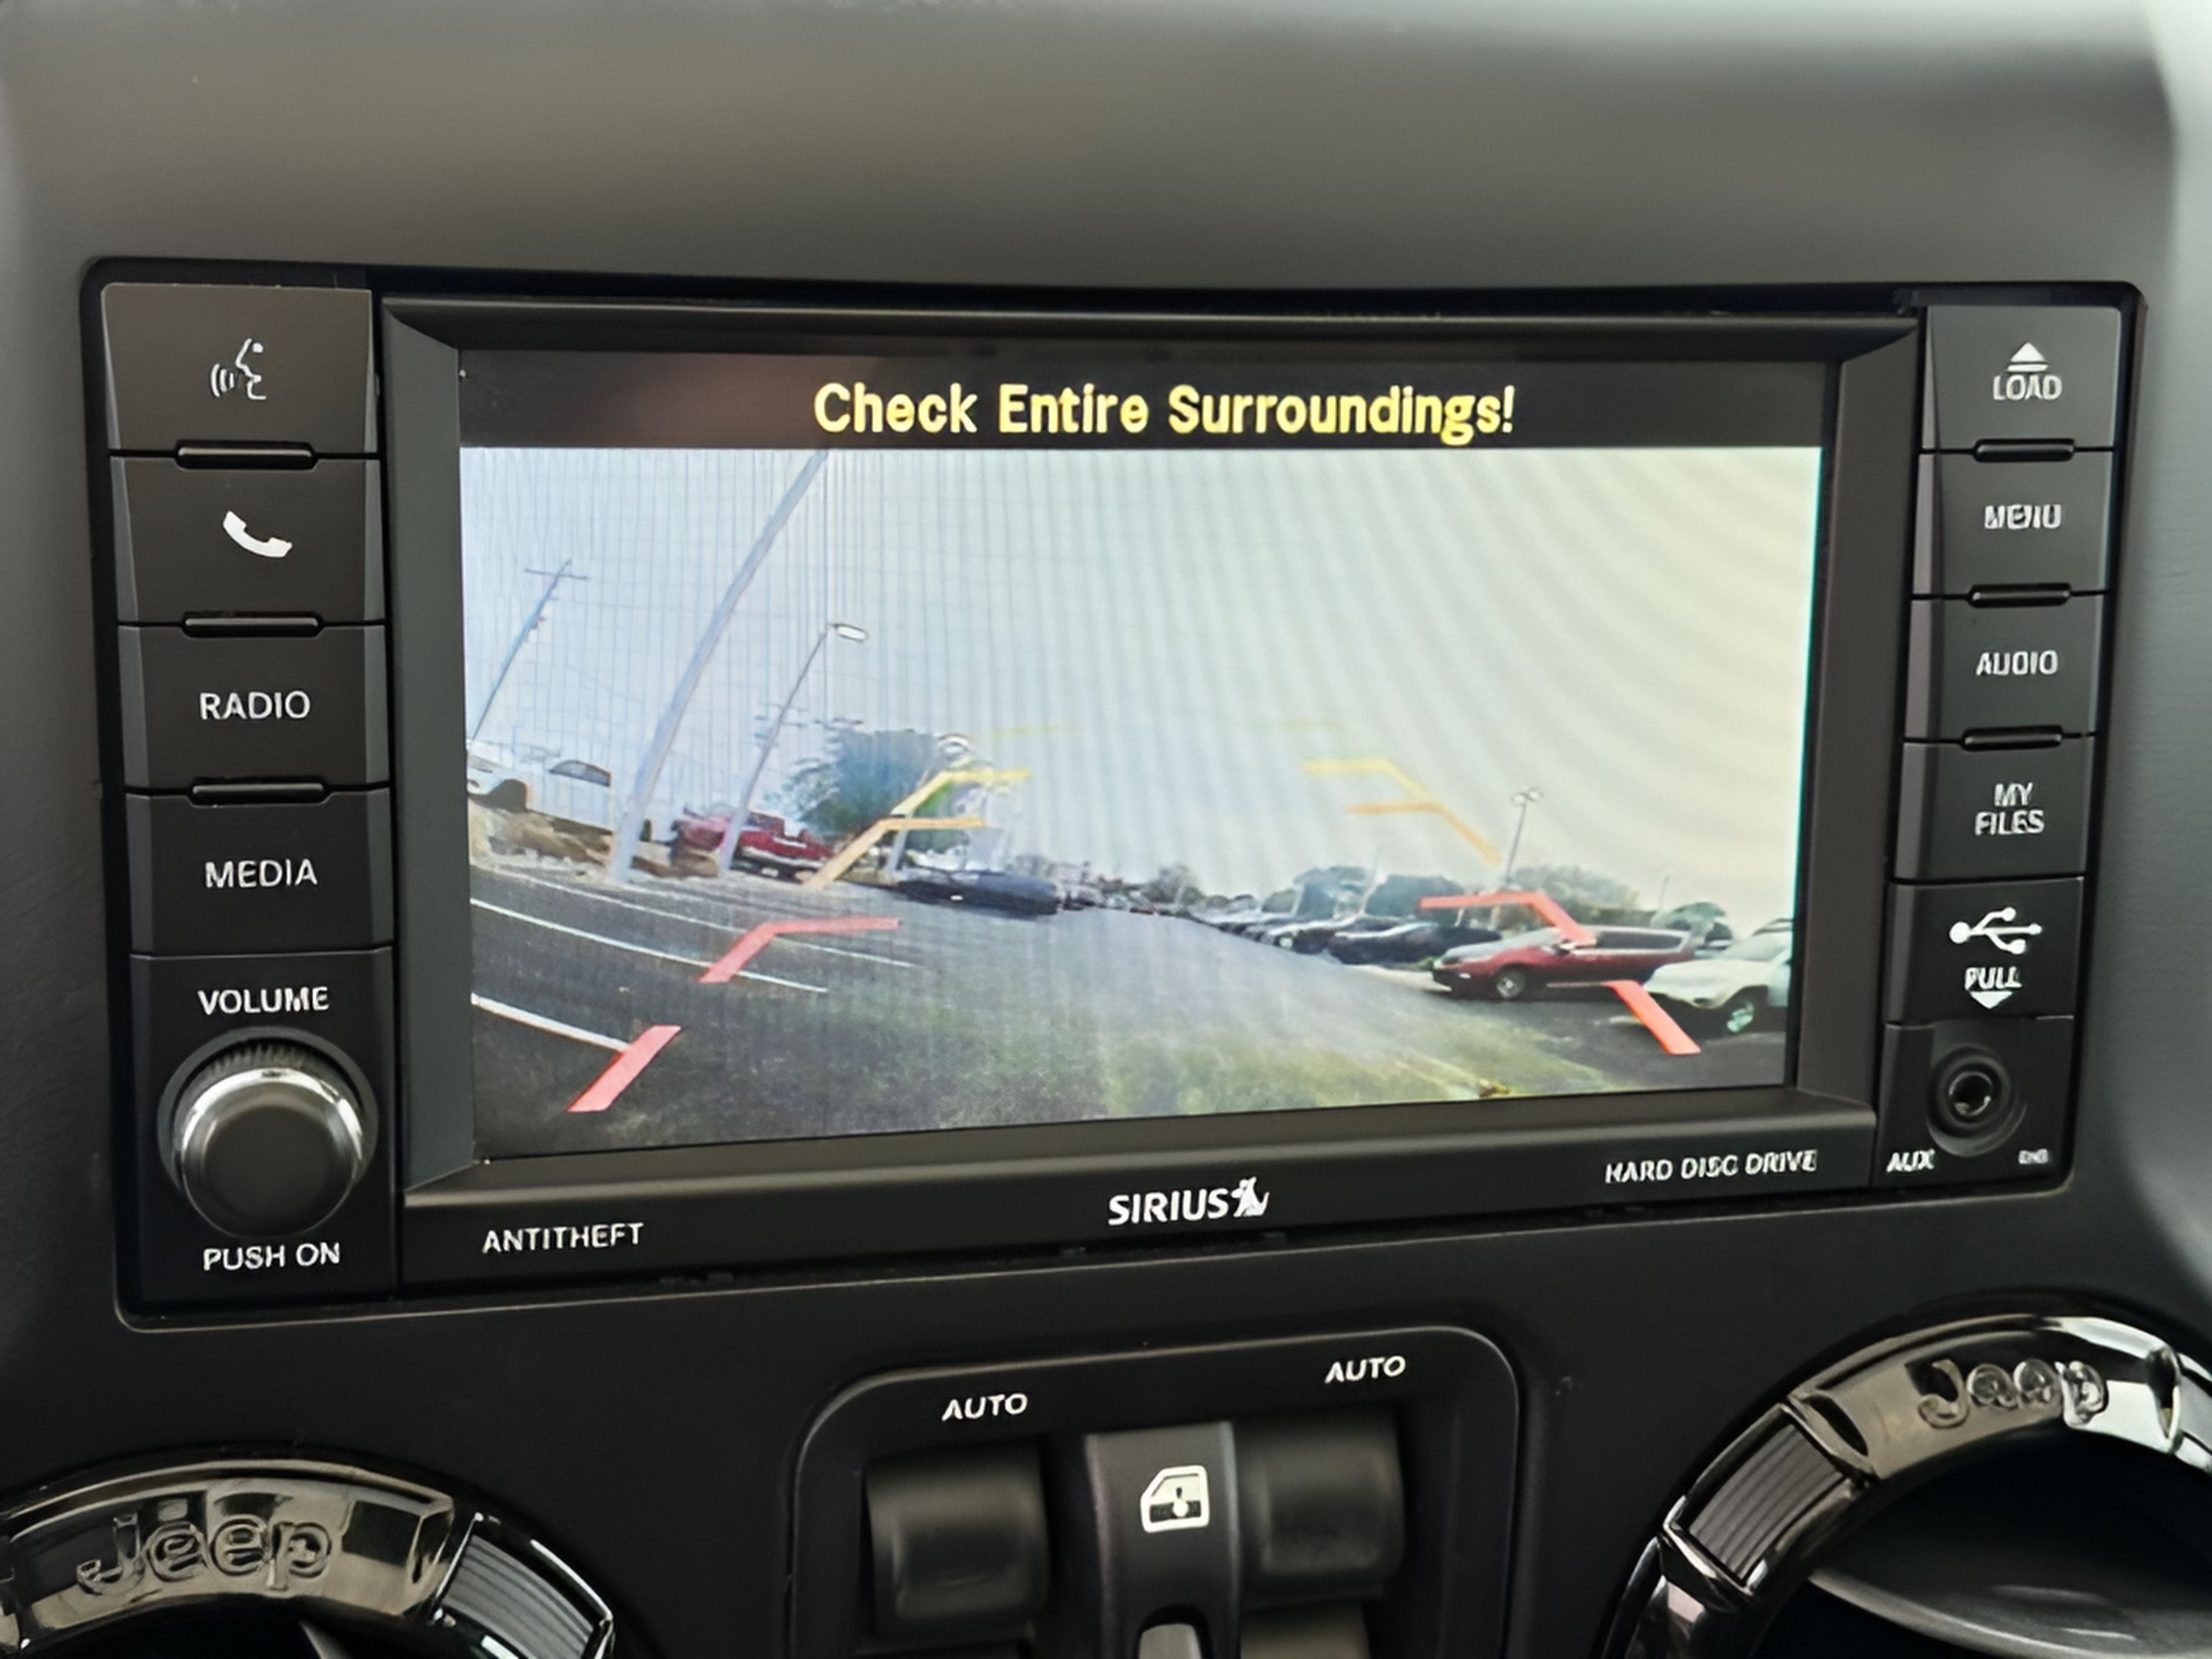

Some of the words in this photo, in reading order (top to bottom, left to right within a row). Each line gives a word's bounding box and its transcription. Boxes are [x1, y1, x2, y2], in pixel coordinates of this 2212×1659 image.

[1992, 374, 2063, 401] LOAD
[813, 382, 978, 434] Check
[998, 382, 1149, 435] Entire
[1167, 384, 1515, 446] Surroundings!
[1983, 504, 2062, 530] MENU
[1975, 650, 2059, 676] AUDIO
[199, 690, 311, 720] RADIO
[1994, 782, 2034, 807] MY
[1974, 810, 2045, 836] FILES
[204, 858, 319, 889] MEDIA
[1964, 966, 2023, 991] PULL
[197, 986, 330, 1016] VOLUME
[1604, 1159, 1674, 1184] HARD
[1680, 1154, 1739, 1181] DISC
[1743, 1149, 1818, 1175] DRIVE
[1886, 1148, 1936, 1173] AUX
[1107, 1187, 1229, 1227] SIRIUS
[482, 1222, 644, 1254] ANTITHEFT
[202, 1244, 286, 1272] PUSH
[295, 1241, 341, 1267] ON
[1325, 1355, 1406, 1384] AUTO
[941, 1392, 1028, 1422] AUTO
[77, 1512, 333, 1595] Jeep
